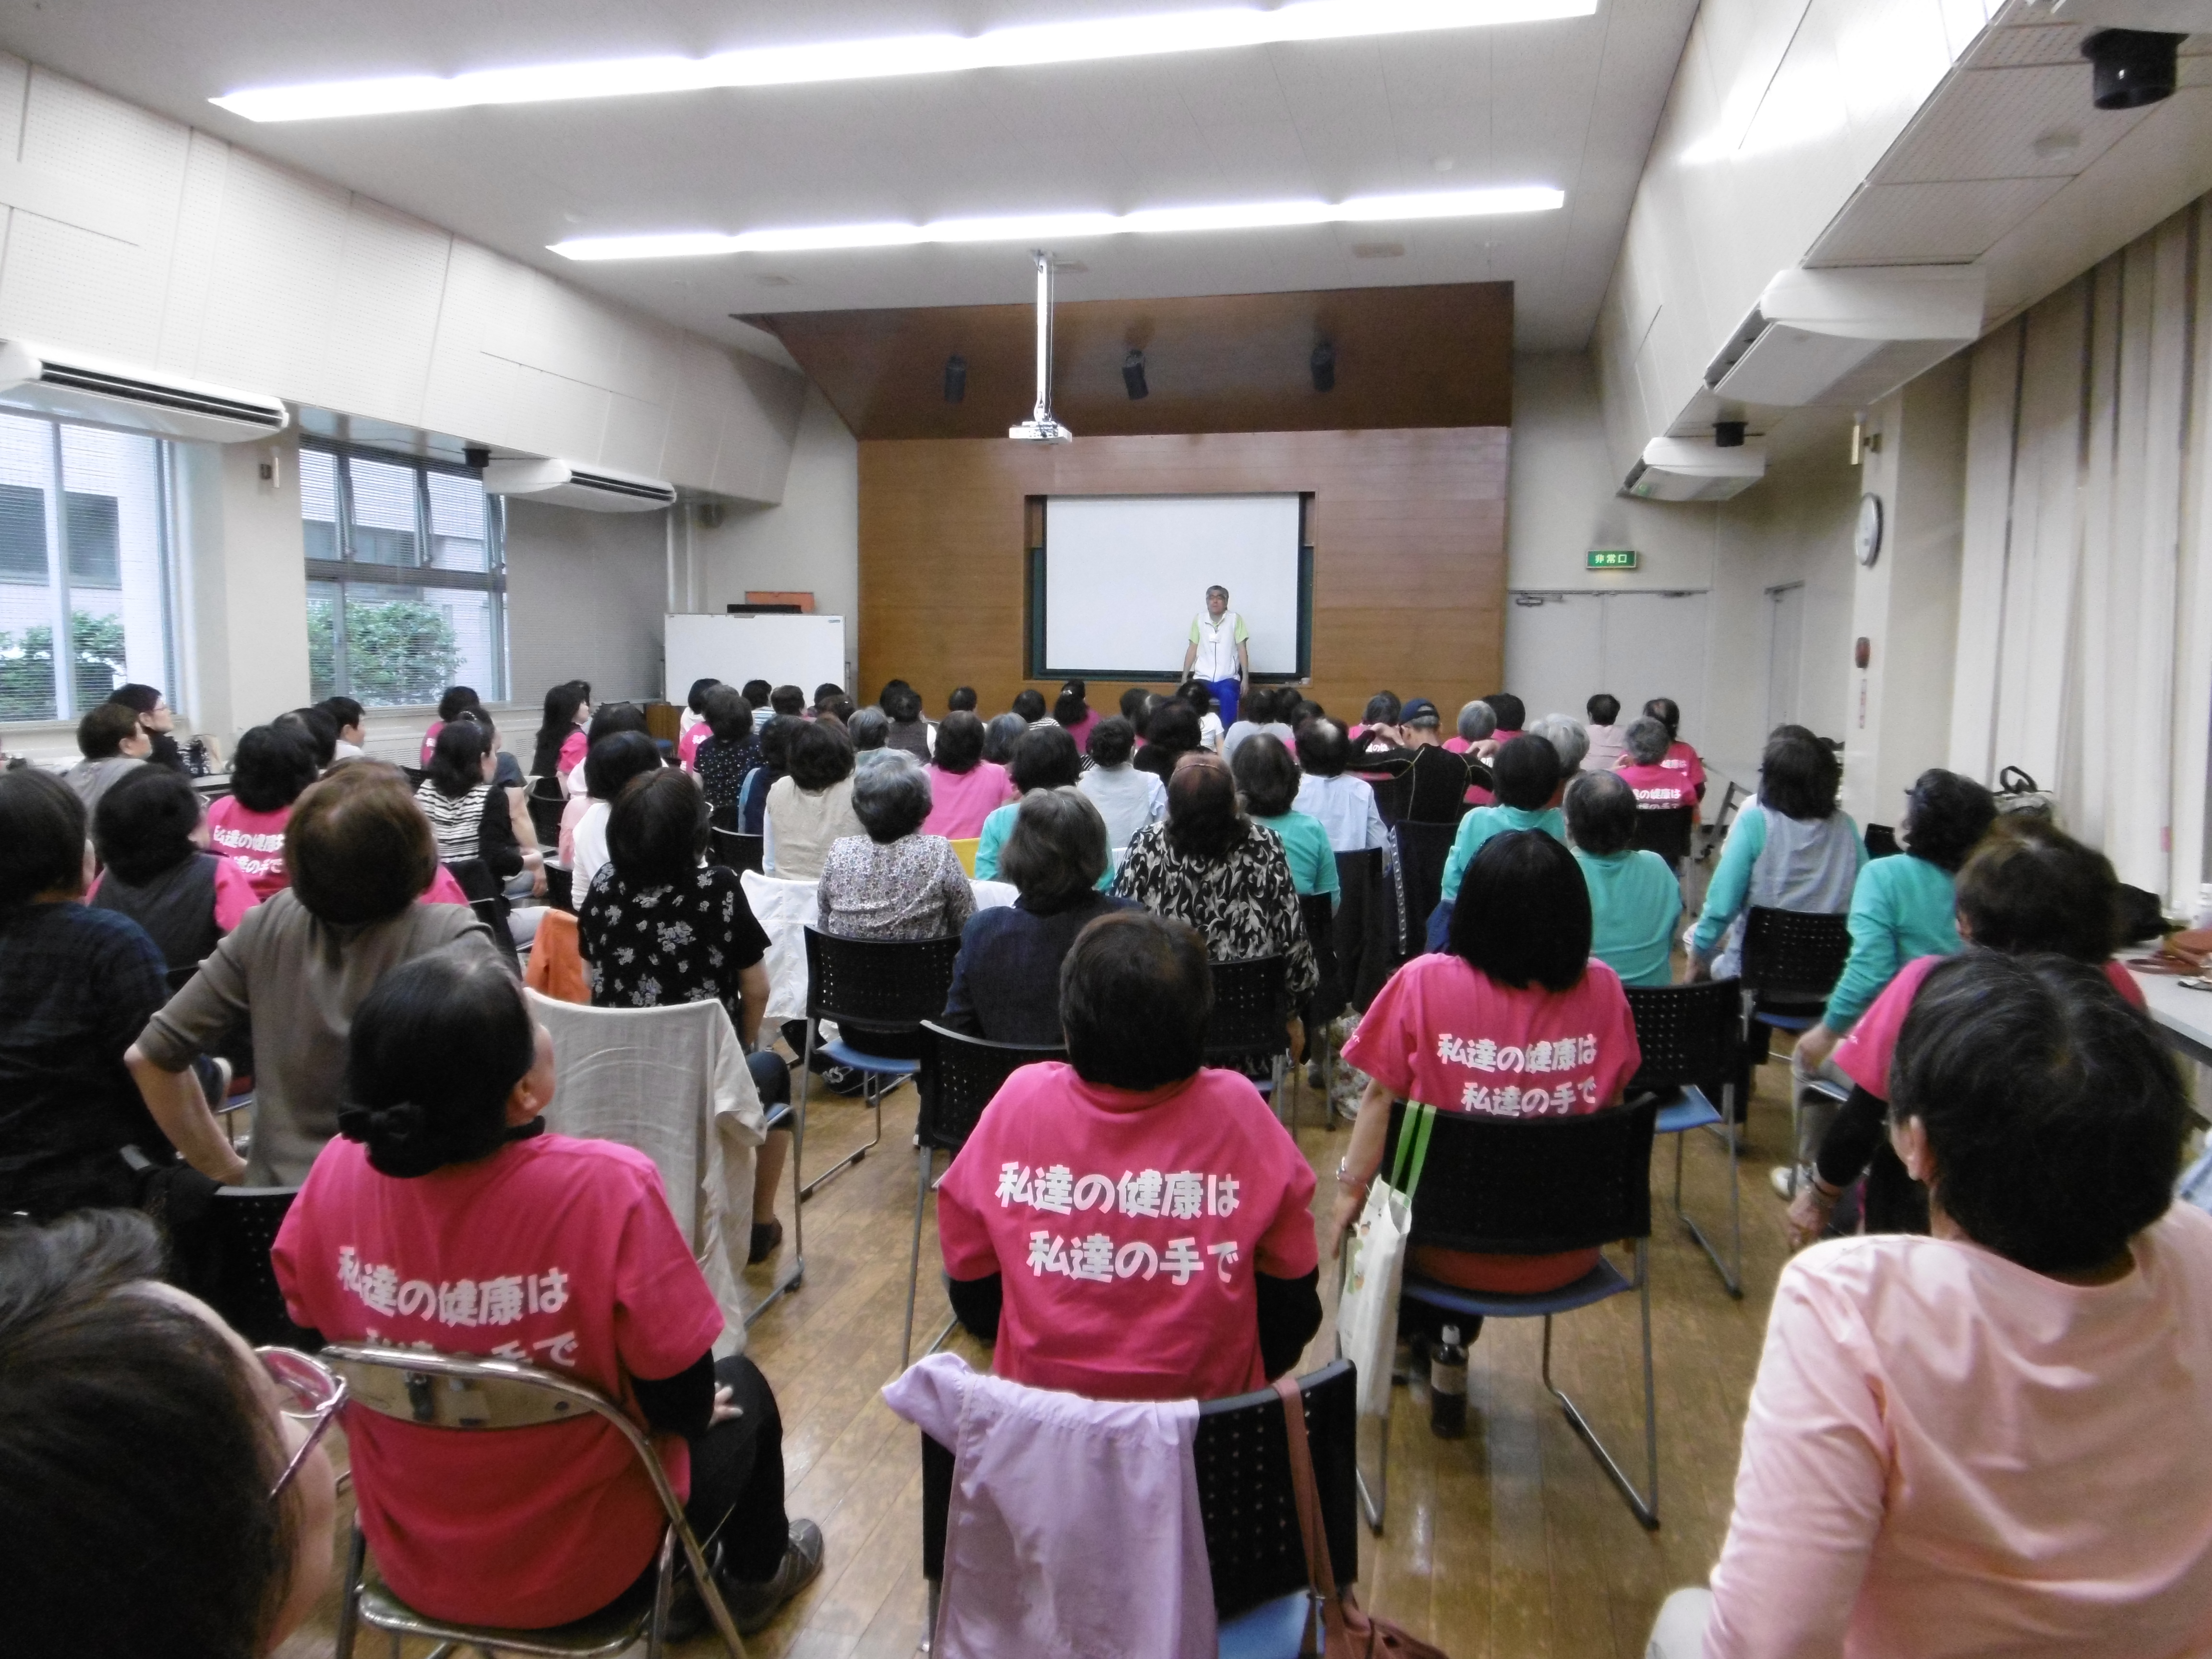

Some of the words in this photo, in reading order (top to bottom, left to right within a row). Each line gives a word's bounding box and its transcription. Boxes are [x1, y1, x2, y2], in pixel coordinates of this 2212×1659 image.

[1595, 554, 1627, 564] 非常口
[1436, 1033, 1598, 1074] 私達の健康は
[1461, 1075, 1597, 1117] 私達の手で
[995, 1161, 1240, 1220] 私達の健康は
[1026, 1229, 1238, 1286] 私達の手で
[337, 1246, 569, 1328] 私達の健康は
